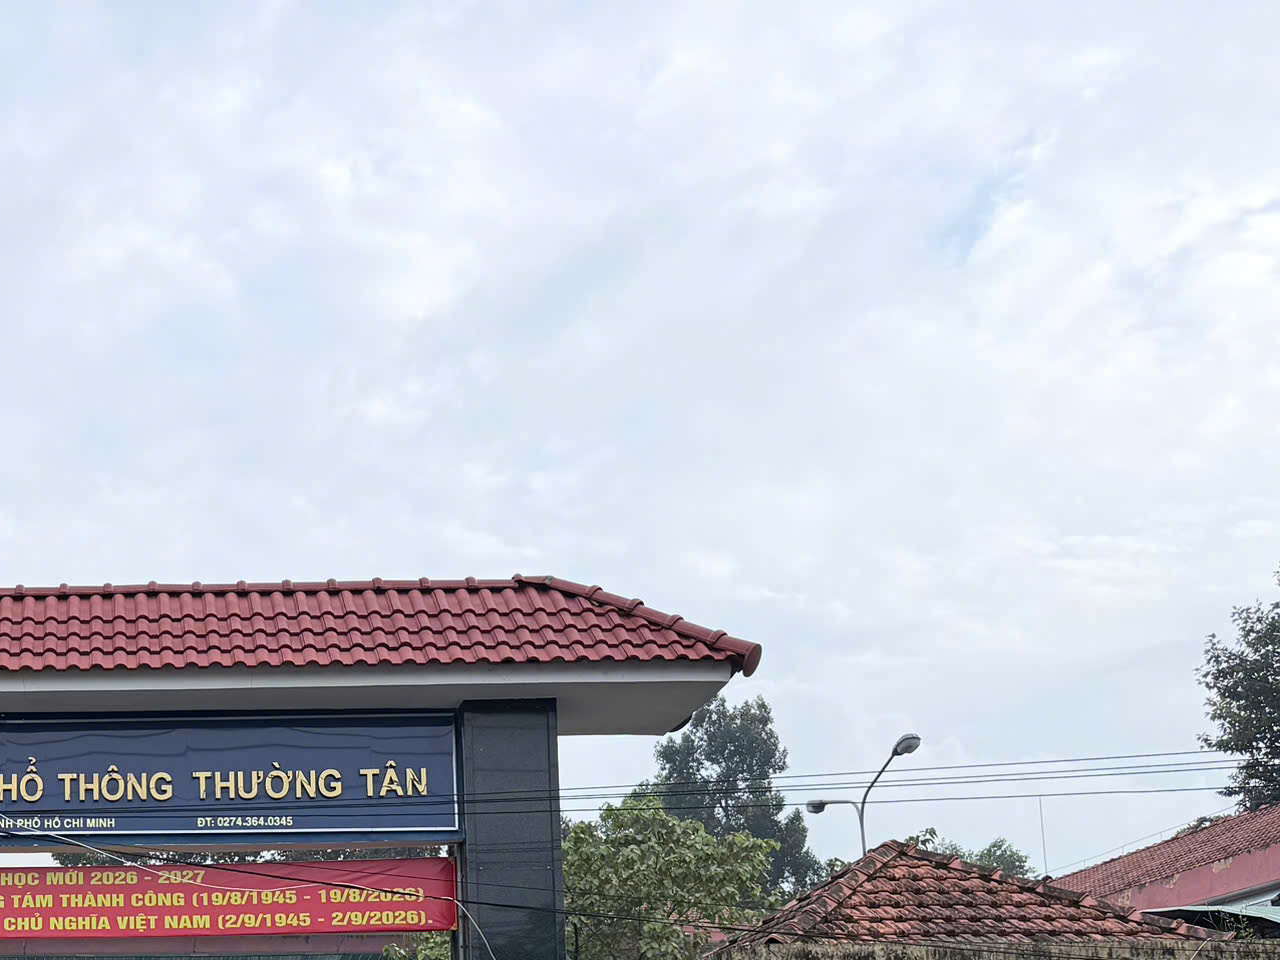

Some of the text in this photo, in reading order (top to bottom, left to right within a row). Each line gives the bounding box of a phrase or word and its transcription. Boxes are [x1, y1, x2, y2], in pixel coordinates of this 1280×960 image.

[58, 765, 174, 802] THÔNG
[192, 761, 343, 800] THƯỜNG
[359, 760, 429, 798] TÂN
[17, 815, 41, 828] PHỐ
[44, 815, 60, 828] HỒ
[64, 815, 83, 828] CHÍ
[86, 818, 115, 828] MINH
[197, 817, 215, 827] ĐT:
[217, 816, 293, 827] 0274.364.0345
[1, 871, 40, 889] HỌC
[46, 869, 84, 885] MỚI
[90, 871, 138, 885] 2026
[158, 870, 206, 884] 2027
[11, 892, 53, 908] TÁM
[59, 891, 125, 907] THÀNH
[131, 891, 185, 907] CÔNG
[192, 890, 297, 908] (19/8/1945
[3, 912, 43, 931] CHỦ
[49, 913, 111, 930] NGHĨA
[117, 913, 158, 932] VIỆT
[164, 915, 211, 929] NAM
[217, 913, 311, 930] (2/9/1945
[331, 910, 433, 926] 2/9/2026).
